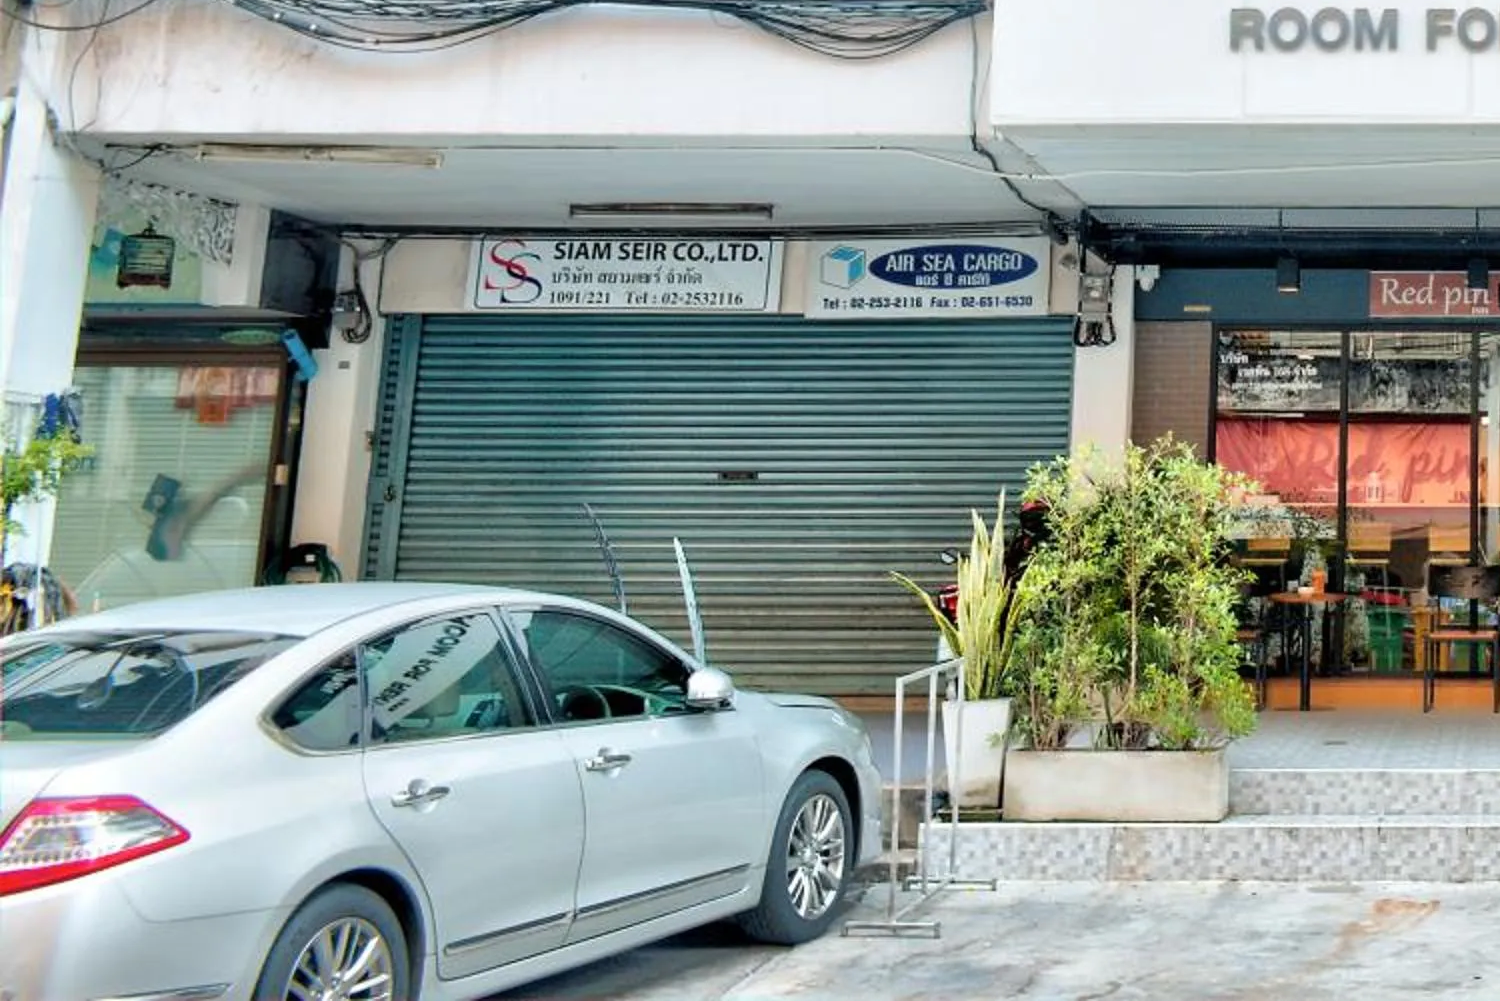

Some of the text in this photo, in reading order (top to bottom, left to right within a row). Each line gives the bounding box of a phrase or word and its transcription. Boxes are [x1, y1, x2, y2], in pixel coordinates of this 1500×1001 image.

[1229, 8, 1398, 52] ROOM
[553, 242, 764, 264] SIAM SEIR CO.,LTD.
[885, 252, 1022, 272] AIR SEA CARGO
[552, 266, 592, 284] บริษัท
[666, 266, 703, 284] จำกัด
[626, 291, 648, 305] Tel
[661, 291, 743, 305] 02-2532116
[823, 298, 839, 310] Tel
[930, 297, 949, 308] Fax
[1380, 274, 1491, 315] Red pin
